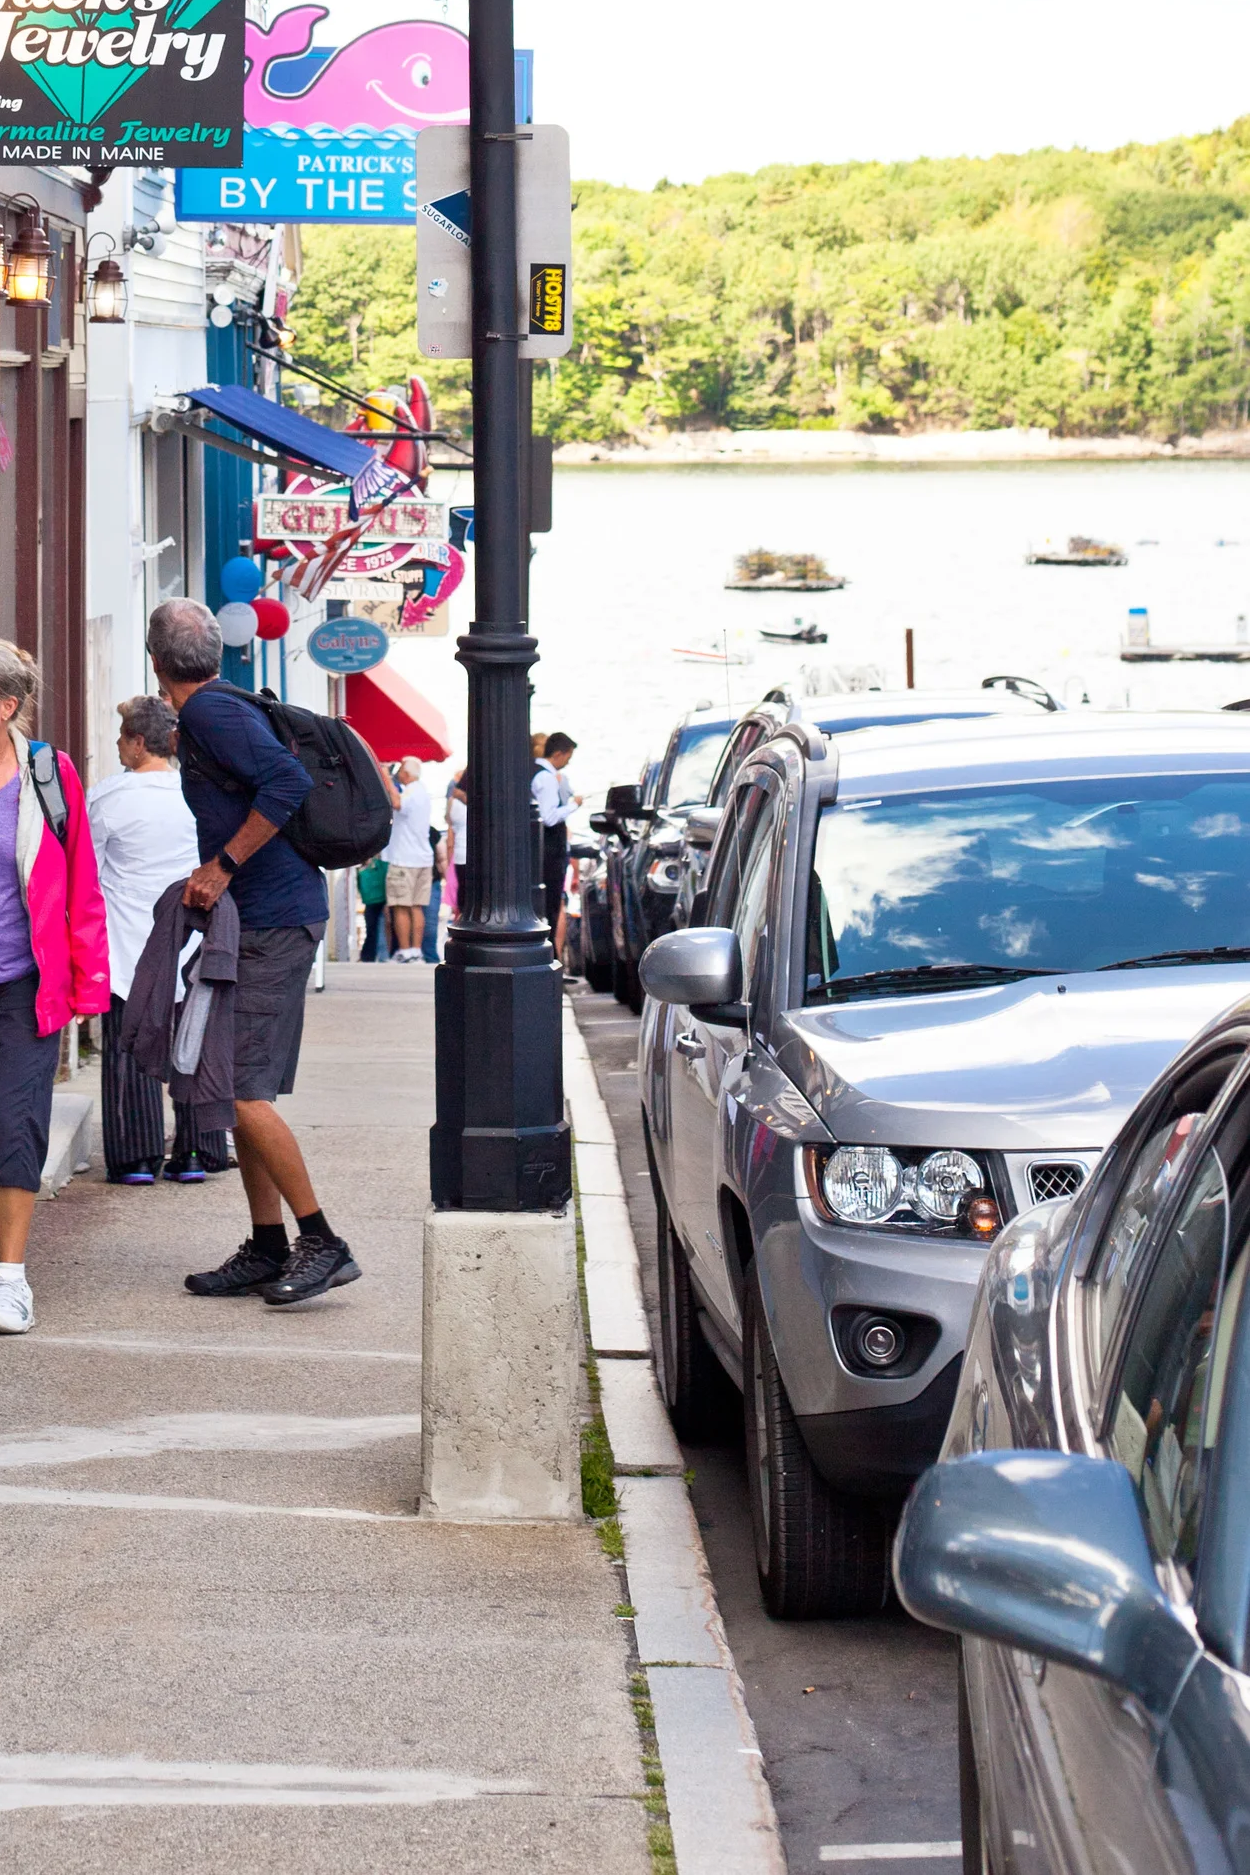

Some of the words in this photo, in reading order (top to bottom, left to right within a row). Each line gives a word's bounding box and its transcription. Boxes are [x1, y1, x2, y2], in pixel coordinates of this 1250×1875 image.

[114, 120, 231, 148] Jewelry
[2, 145, 62, 160] MADE
[72, 146, 91, 160] IN
[101, 146, 164, 161] MAINE
[298, 154, 414, 174] PATRICK'S
[220, 177, 278, 209] BY
[296, 178, 385, 211] THE
[421, 204, 471, 248] SUGARLOA
[364, 551, 395, 570] 1974
